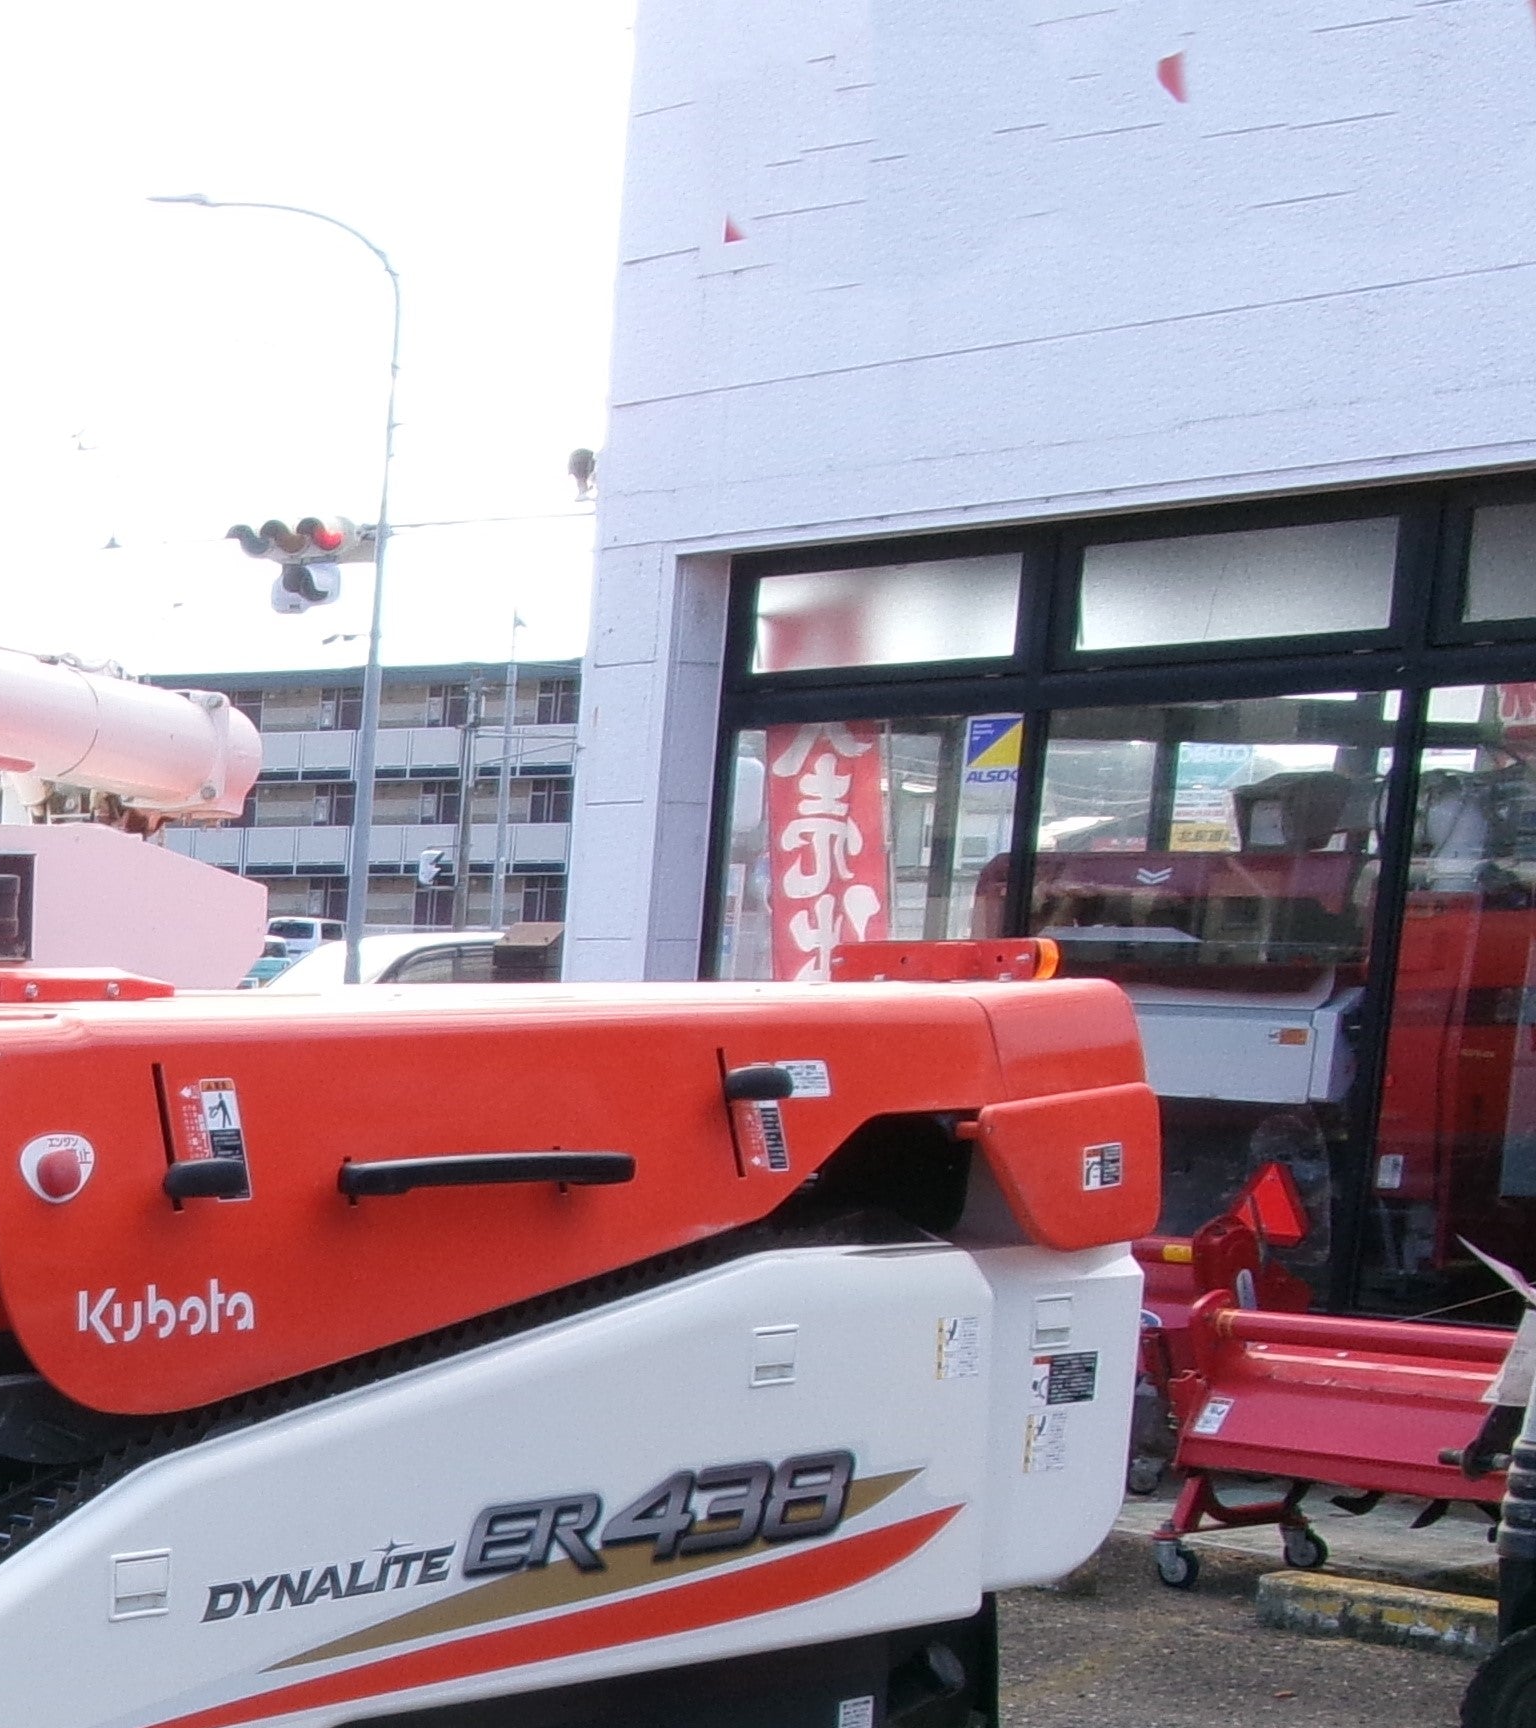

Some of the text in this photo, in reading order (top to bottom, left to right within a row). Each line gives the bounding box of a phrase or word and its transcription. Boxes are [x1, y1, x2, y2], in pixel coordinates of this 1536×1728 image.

[78, 1278, 254, 1344] Kubota
[199, 1449, 857, 1623] DYNALITE ER438
